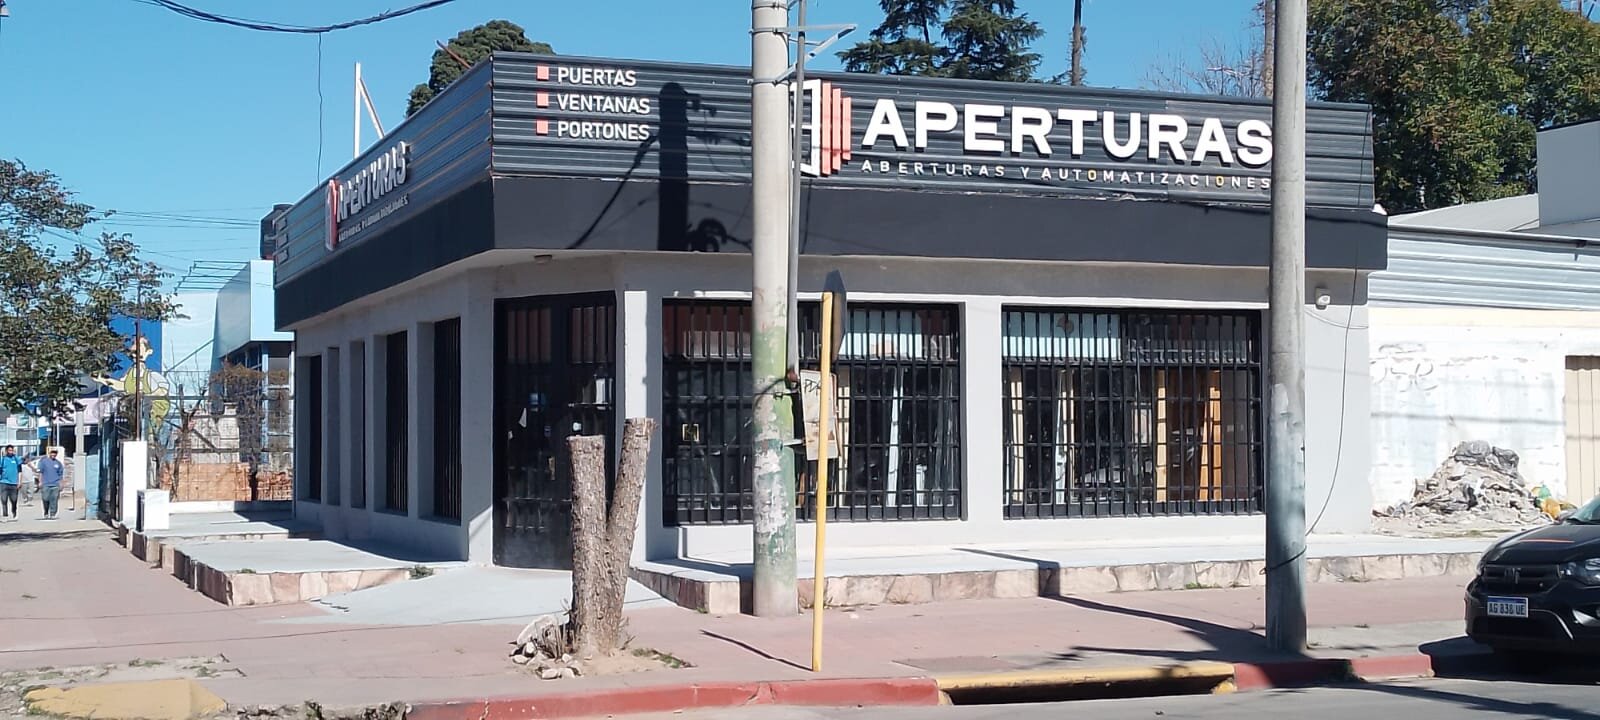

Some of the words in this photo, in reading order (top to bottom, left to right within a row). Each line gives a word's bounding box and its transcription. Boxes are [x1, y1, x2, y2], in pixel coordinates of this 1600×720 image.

[557, 67, 637, 87] PUERTAS
[557, 93, 651, 115] VENTANAS
[557, 120, 650, 141] PORTONES
[862, 98, 1273, 166] APERTURAS
[861, 159, 1006, 177] ABERTURAS
[1019, 166, 1031, 179] Y
[1040, 167, 1271, 190] AUTOMATIZACIONES
